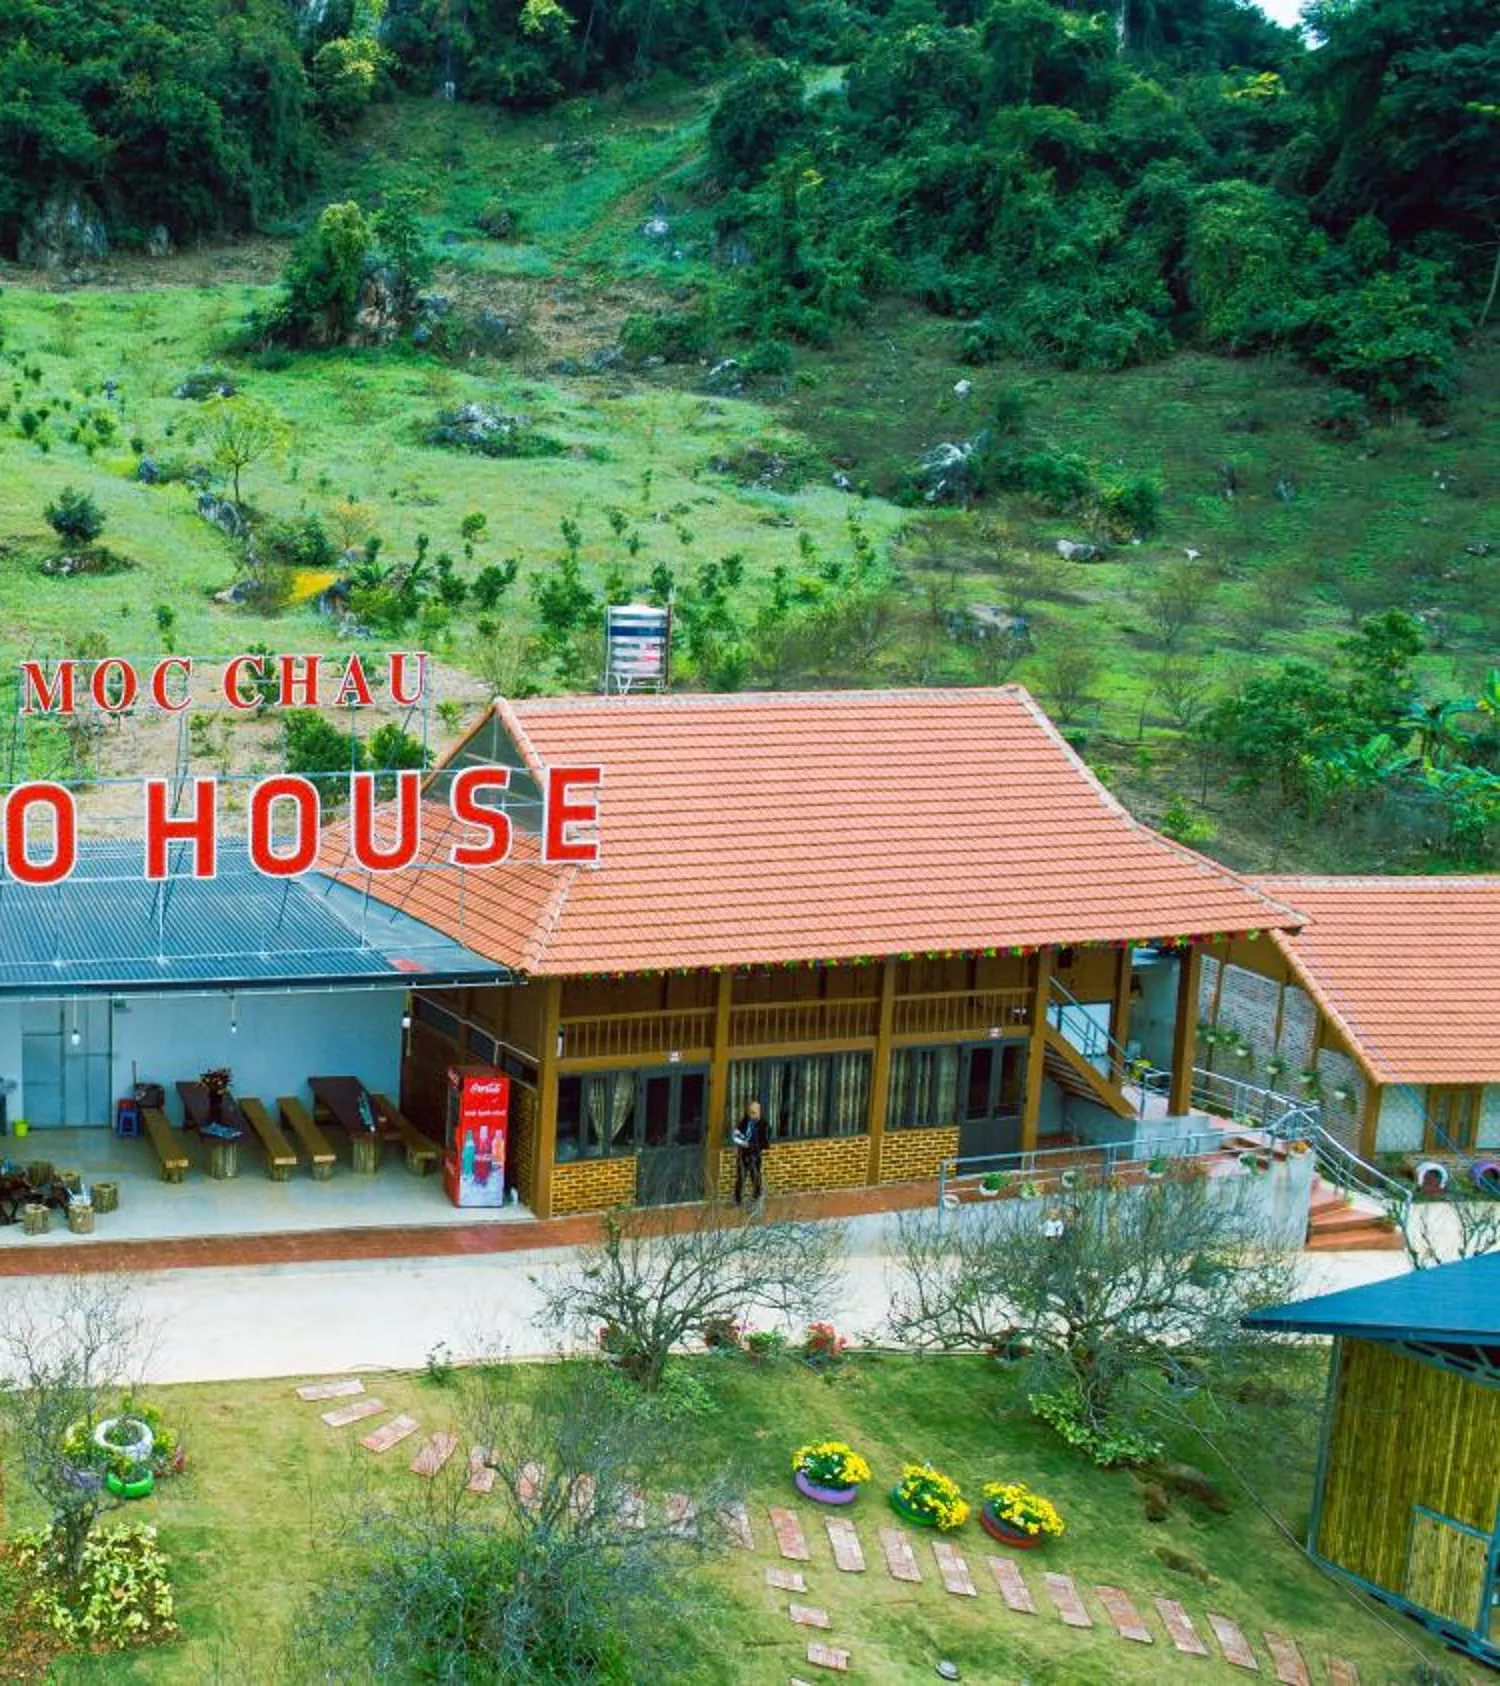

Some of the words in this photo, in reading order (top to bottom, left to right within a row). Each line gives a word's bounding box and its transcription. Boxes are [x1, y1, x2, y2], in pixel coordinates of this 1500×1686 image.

[20, 656, 192, 715] MOC
[223, 651, 429, 710] CHAU
[144, 764, 604, 879] HOUSE
